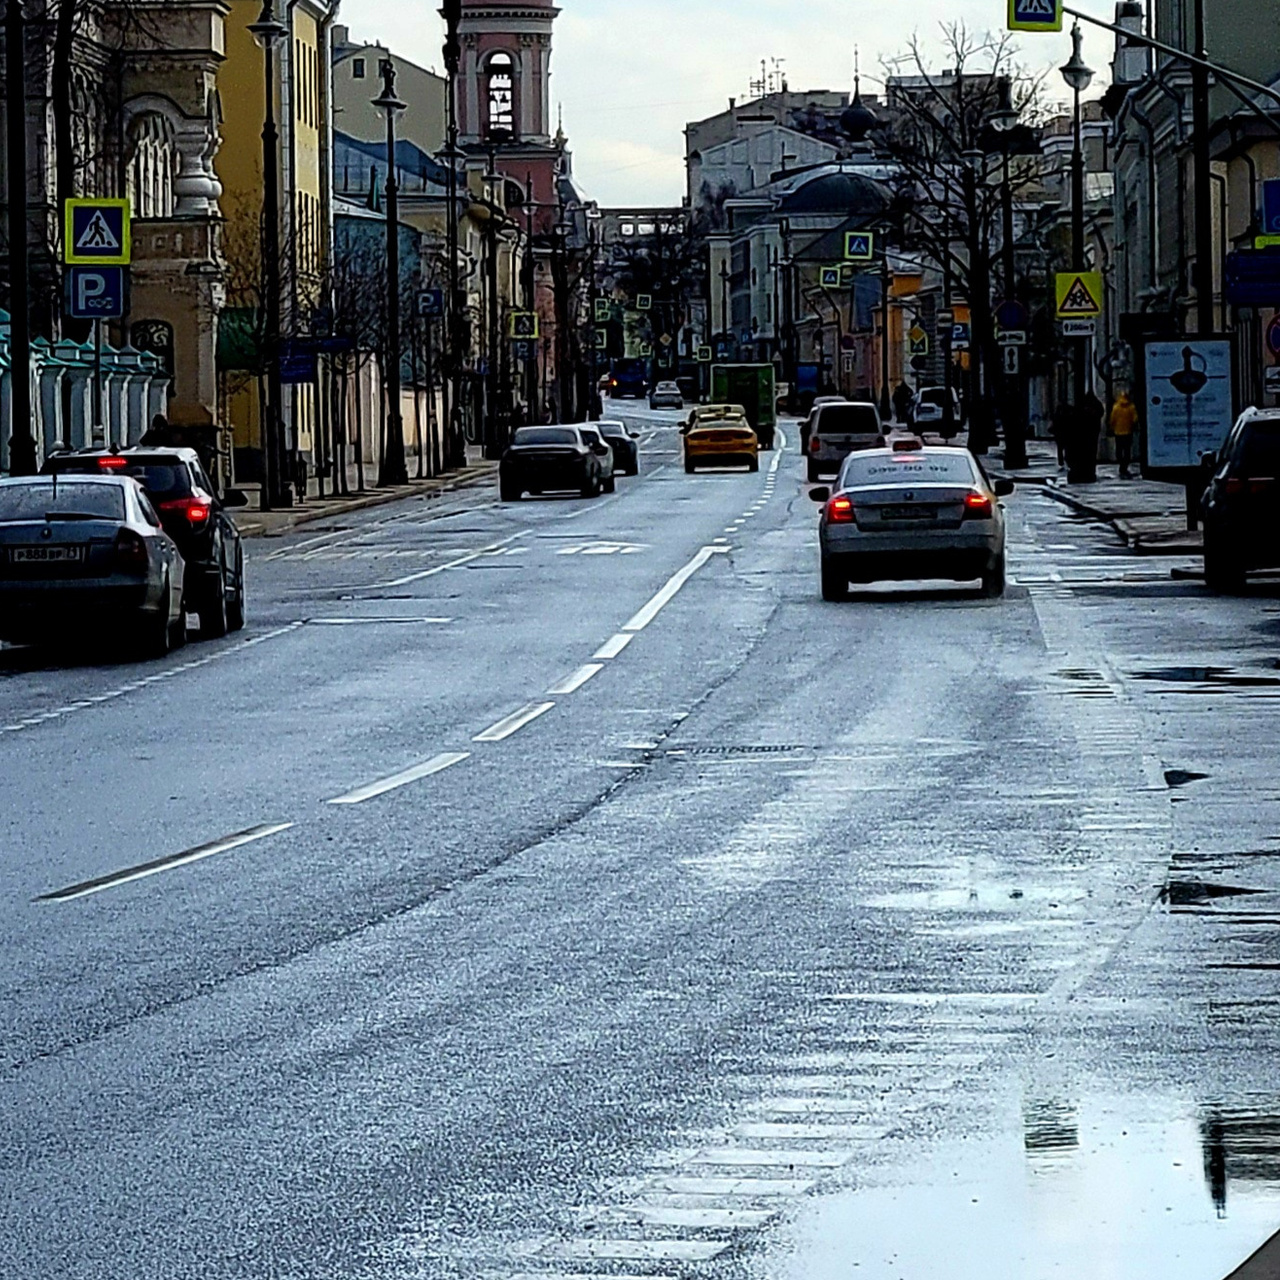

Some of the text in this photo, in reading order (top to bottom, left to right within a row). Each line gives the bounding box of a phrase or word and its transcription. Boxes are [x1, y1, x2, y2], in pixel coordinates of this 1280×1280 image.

[78, 273, 106, 310] P
[418, 292, 434, 314] P
[953, 325, 964, 339] P
